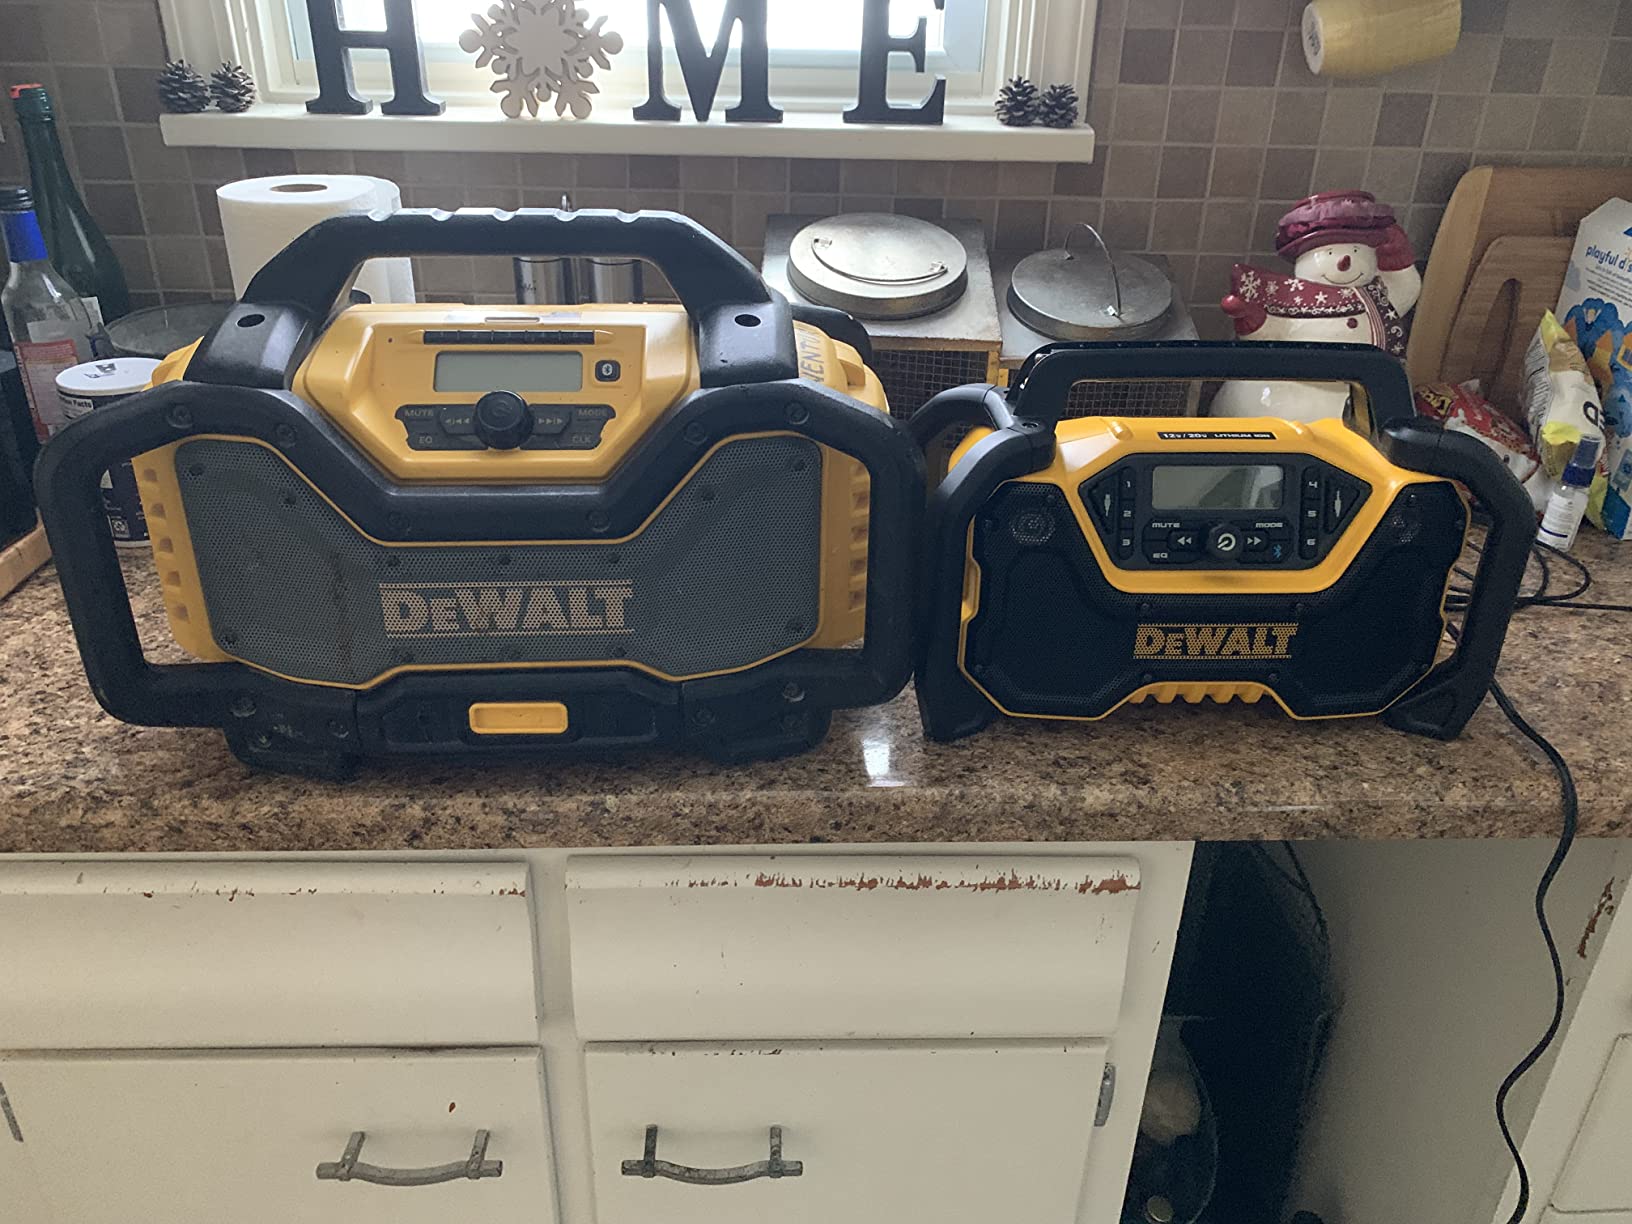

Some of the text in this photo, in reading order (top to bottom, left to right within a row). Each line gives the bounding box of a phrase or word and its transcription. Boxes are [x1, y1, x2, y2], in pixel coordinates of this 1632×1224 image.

[1586, 244, 1620, 267] playful
[1125, 480, 1131, 488] 1
[1308, 480, 1318, 489] 4
[1123, 510, 1132, 518] 2
[1307, 510, 1317, 518] 5
[1151, 521, 1181, 529] MUTE
[1255, 521, 1284, 529] MODE
[1122, 538, 1131, 547] 3
[1306, 538, 1316, 546] 6
[1152, 552, 1169, 560] EQ
[380, 583, 634, 635] DEWALT
[1133, 625, 1298, 657] DEWALT
